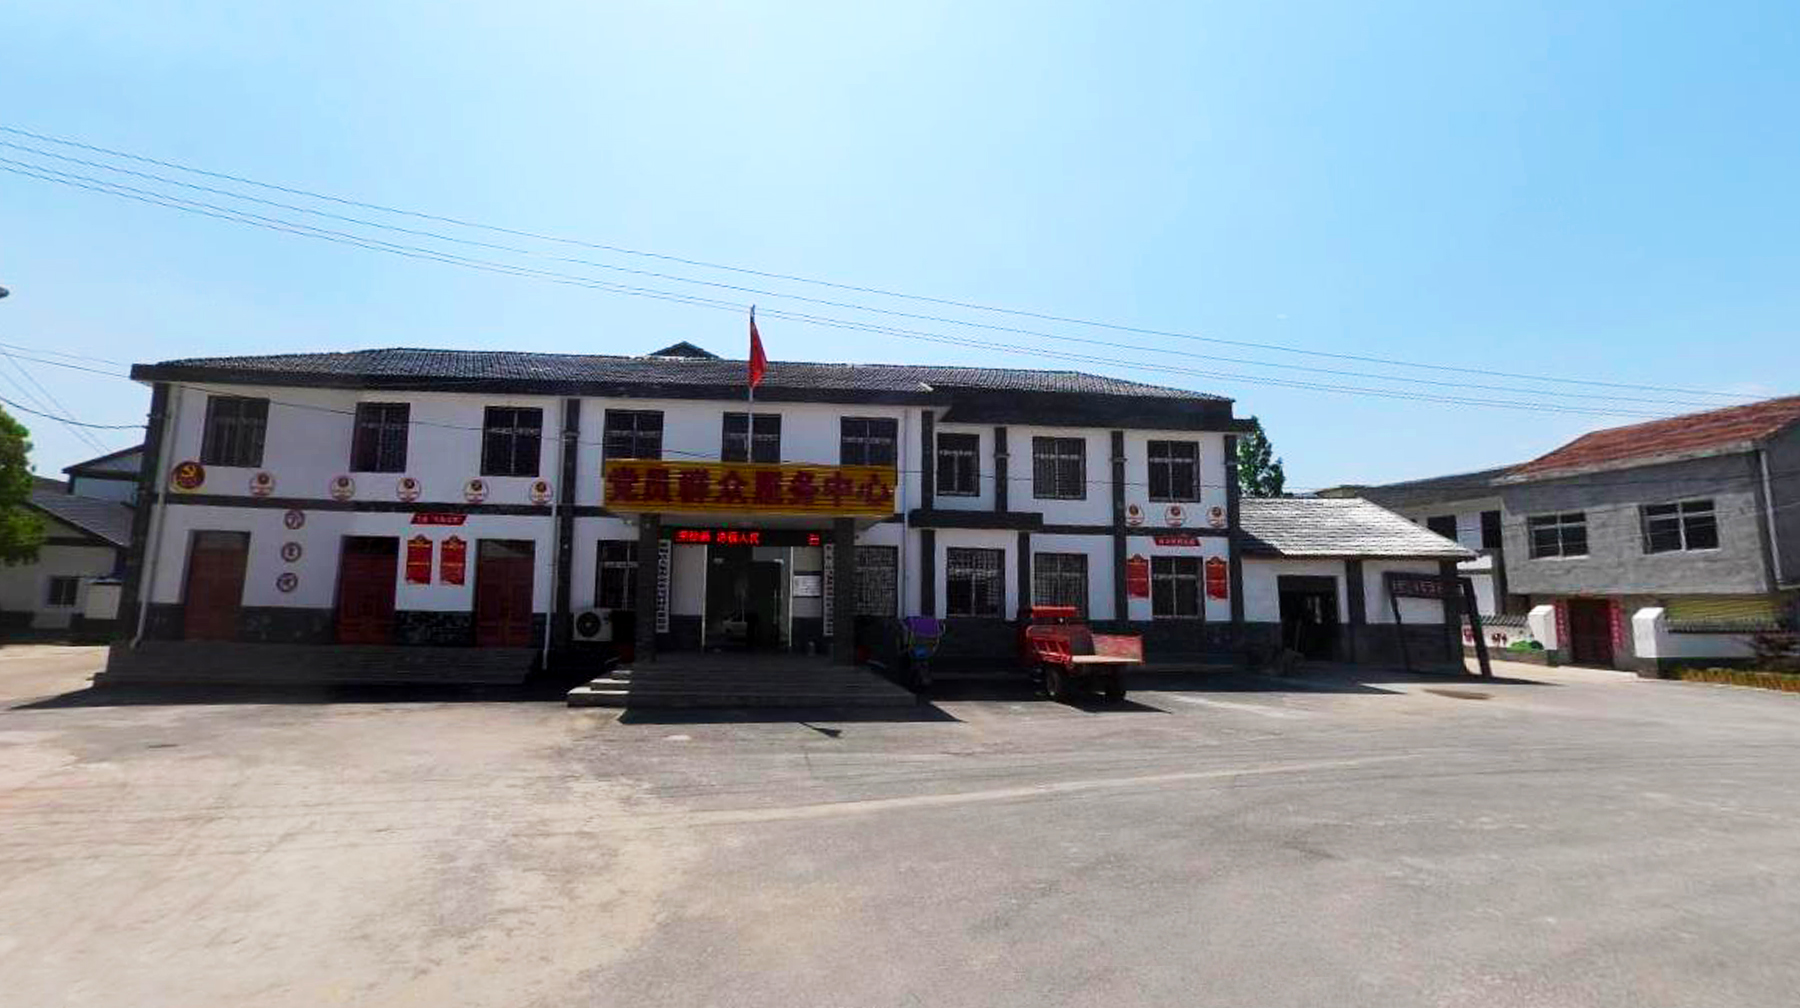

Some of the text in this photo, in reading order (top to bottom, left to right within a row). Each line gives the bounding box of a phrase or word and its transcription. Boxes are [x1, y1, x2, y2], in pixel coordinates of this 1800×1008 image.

[607, 466, 894, 507] 党员群众服务中心
